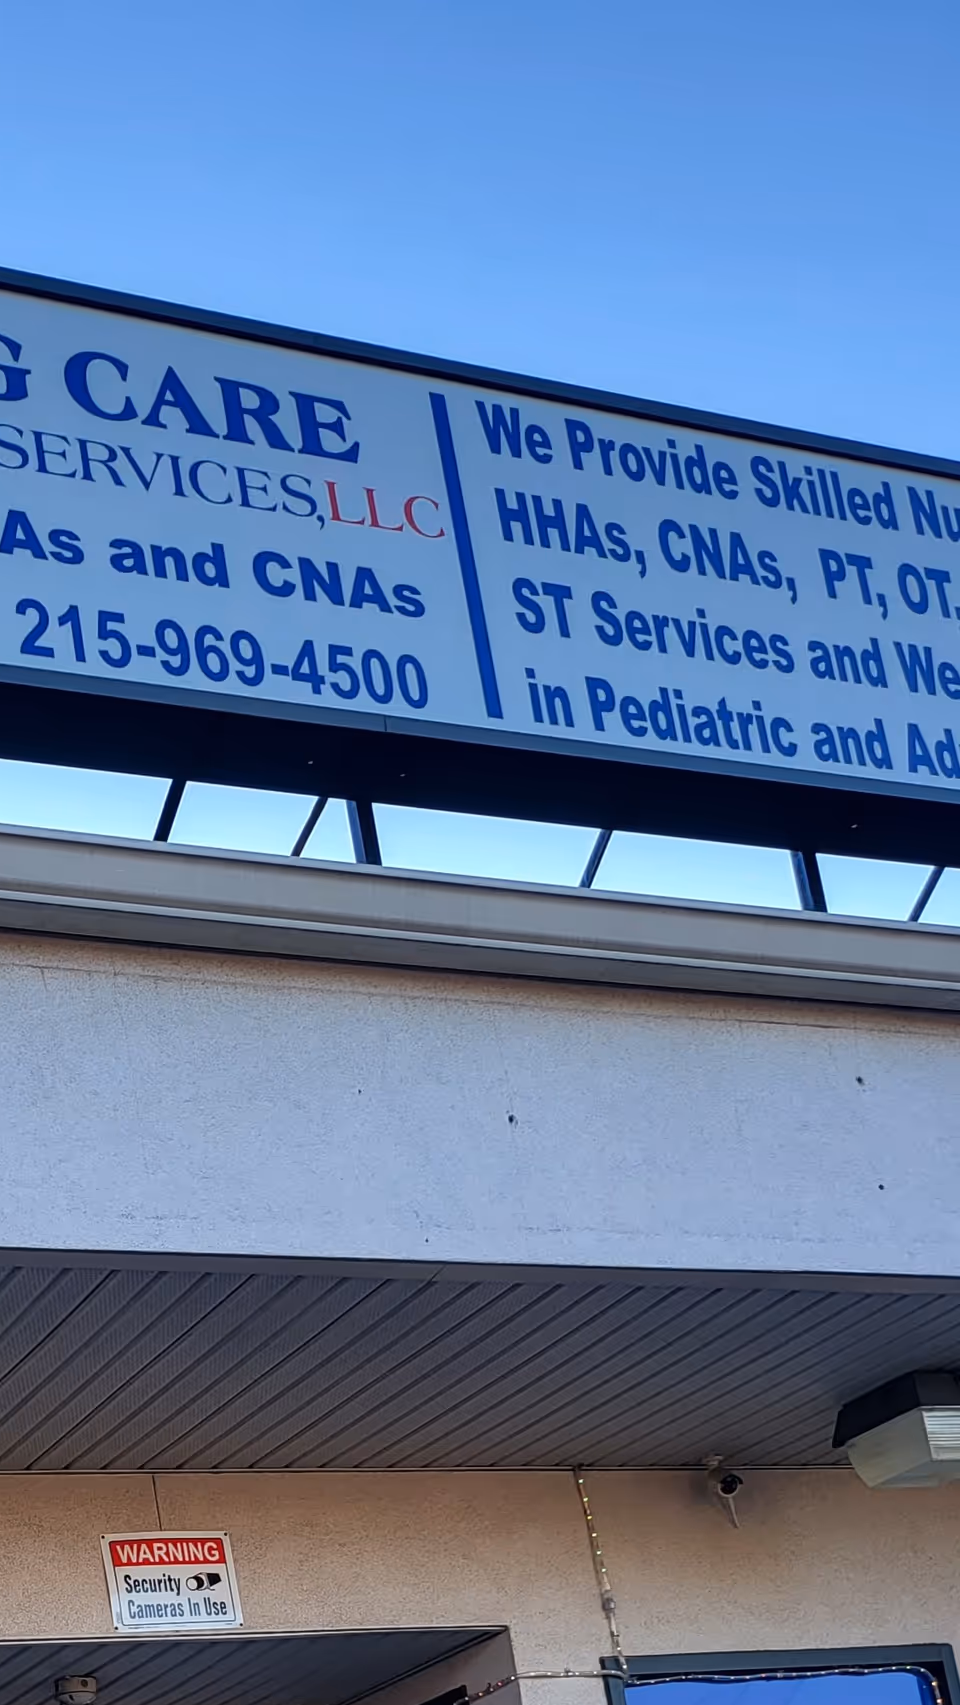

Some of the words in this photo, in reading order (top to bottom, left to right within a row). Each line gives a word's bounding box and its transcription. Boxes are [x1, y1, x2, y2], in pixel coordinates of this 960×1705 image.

[64, 350, 360, 464] CARE
[475, 399, 553, 464] We
[564, 417, 739, 500] Provide
[749, 455, 899, 532] Skilled
[109, 535, 230, 589] and
[252, 549, 425, 618] CNAs
[494, 487, 648, 579] HHAs,
[658, 518, 797, 605] CNAs,
[818, 548, 888, 621] PT,
[16, 598, 428, 709] 215-969-4500
[511, 577, 572, 639] ST
[591, 590, 795, 675] Services
[807, 637, 888, 690] and
[525, 667, 575, 729] in
[584, 675, 798, 758] Pediatric
[811, 718, 894, 771] and
[116, 1541, 220, 1563] WARNING
[124, 1573, 181, 1596] Security
[127, 1599, 185, 1620] Cameras
[188, 1597, 201, 1616] In
[203, 1597, 228, 1616] Use
